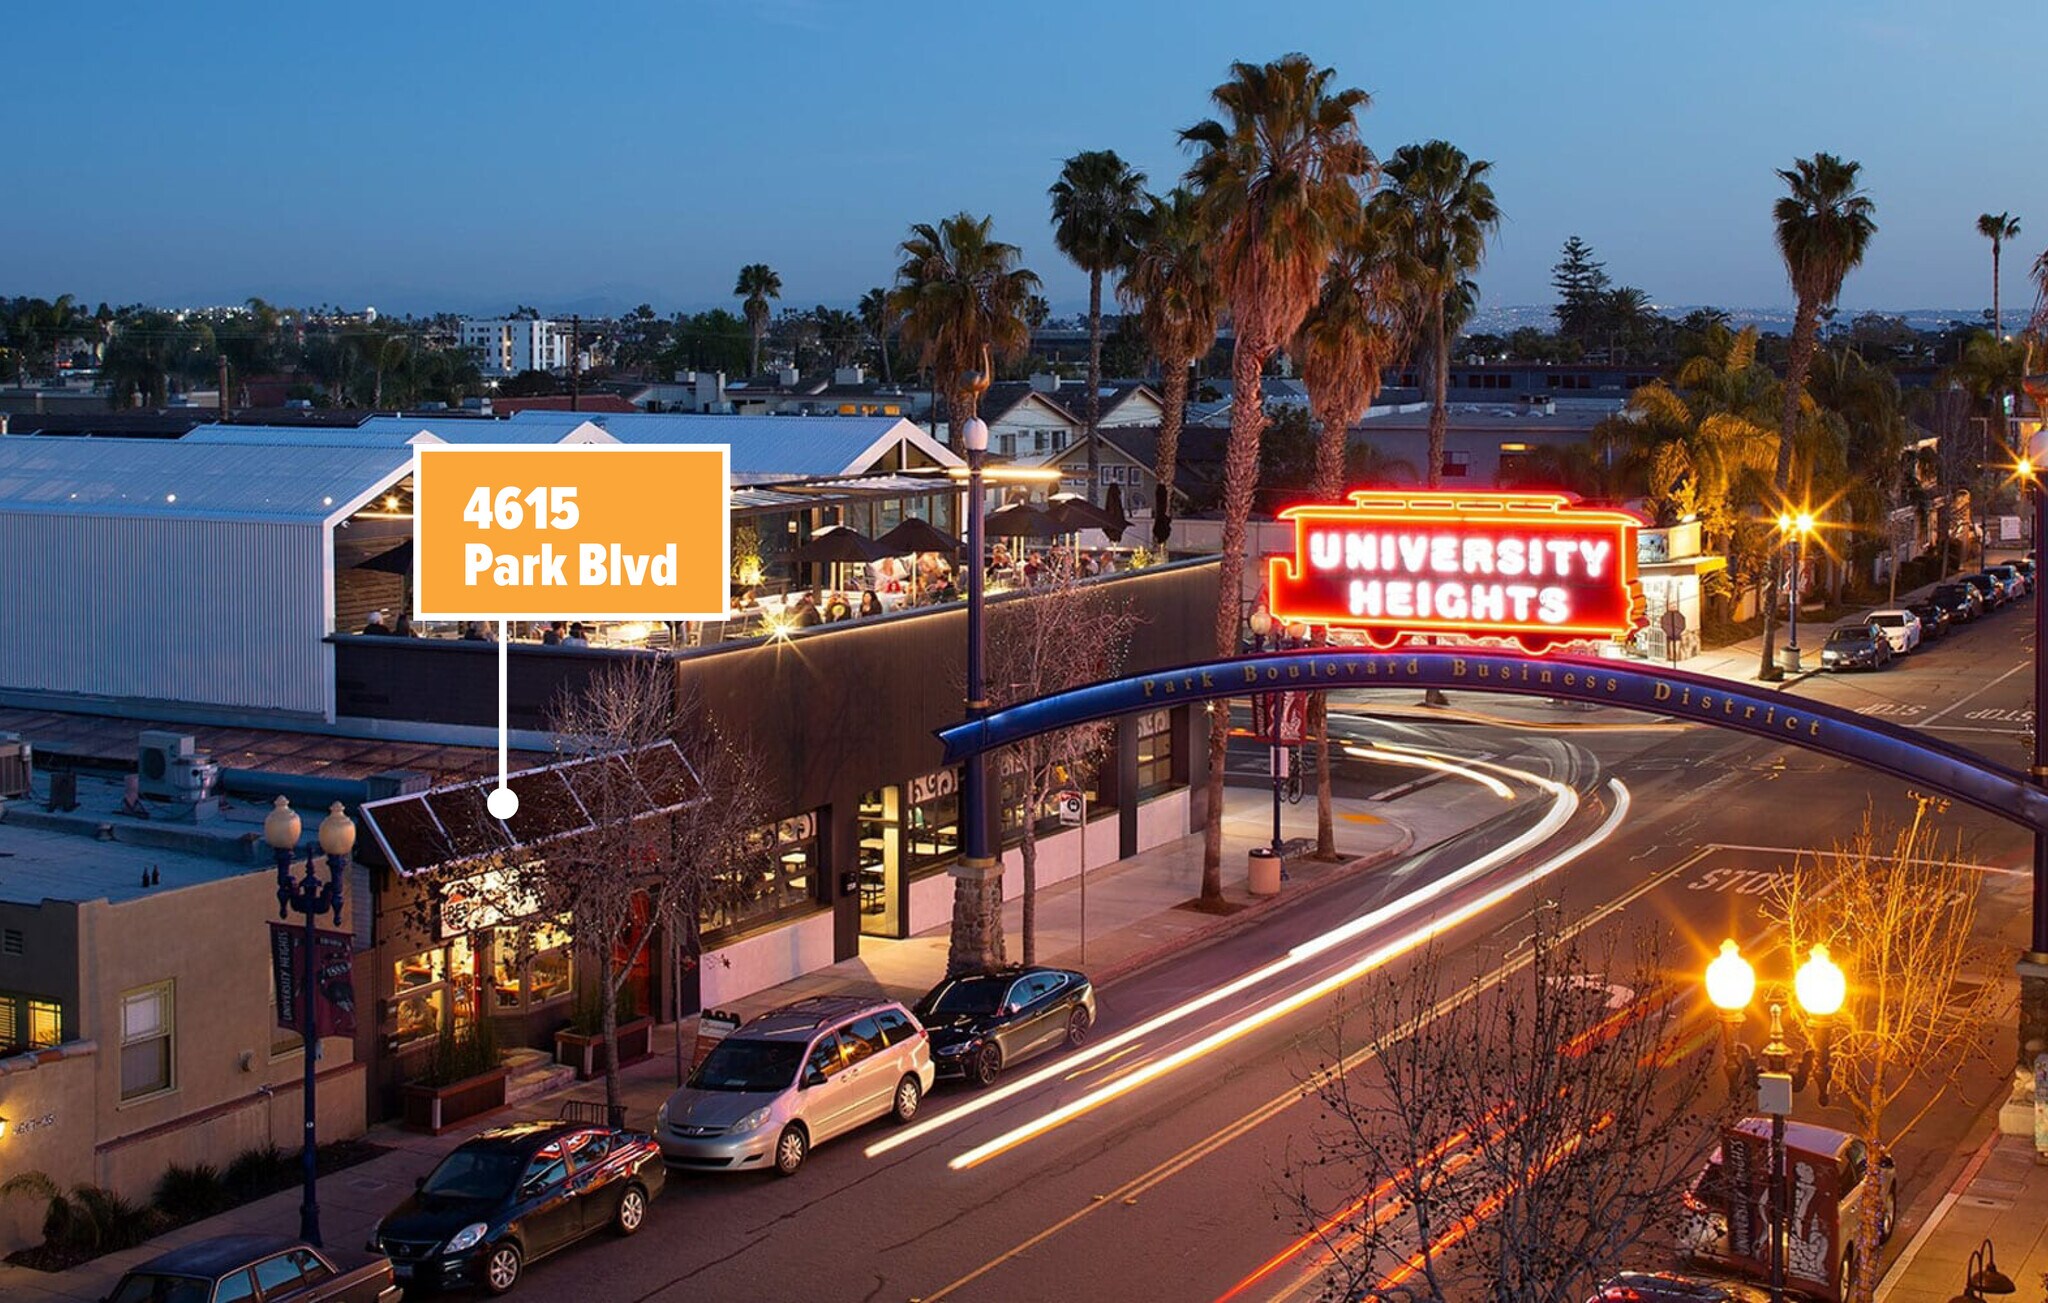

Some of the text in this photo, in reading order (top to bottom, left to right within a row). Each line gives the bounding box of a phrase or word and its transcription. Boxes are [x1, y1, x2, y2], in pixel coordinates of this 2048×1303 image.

[1309, 532, 1611, 577] UNIVERSITY
[1349, 580, 1570, 624] HEIGHTS
[1143, 658, 1820, 736] Park Boulevard Business District
[1964, 708, 2036, 722] STOP
[1688, 868, 1797, 896] STOP
[280, 971, 293, 1020] UNIVERSITY
